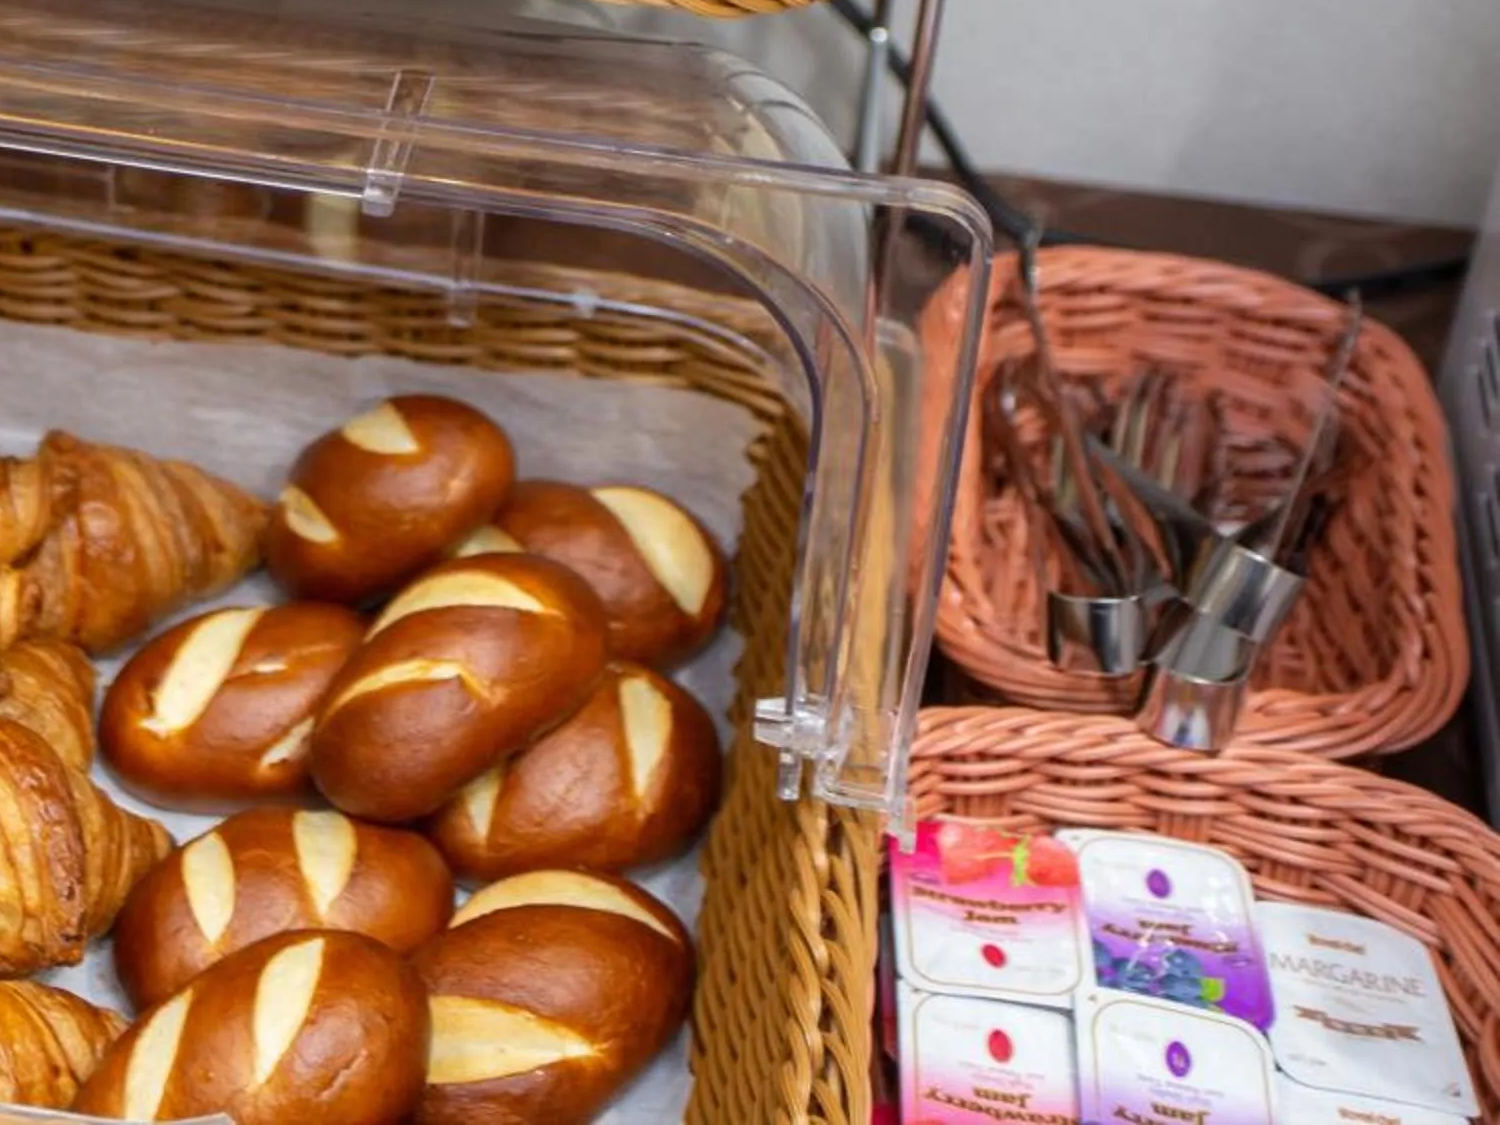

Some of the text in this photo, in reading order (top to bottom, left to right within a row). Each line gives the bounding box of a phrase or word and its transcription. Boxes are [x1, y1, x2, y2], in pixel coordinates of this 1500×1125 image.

[1270, 952, 1427, 998] MARGARINE
[924, 1087, 1079, 1125] trawberry
[972, 1086, 1032, 1109] Jam
